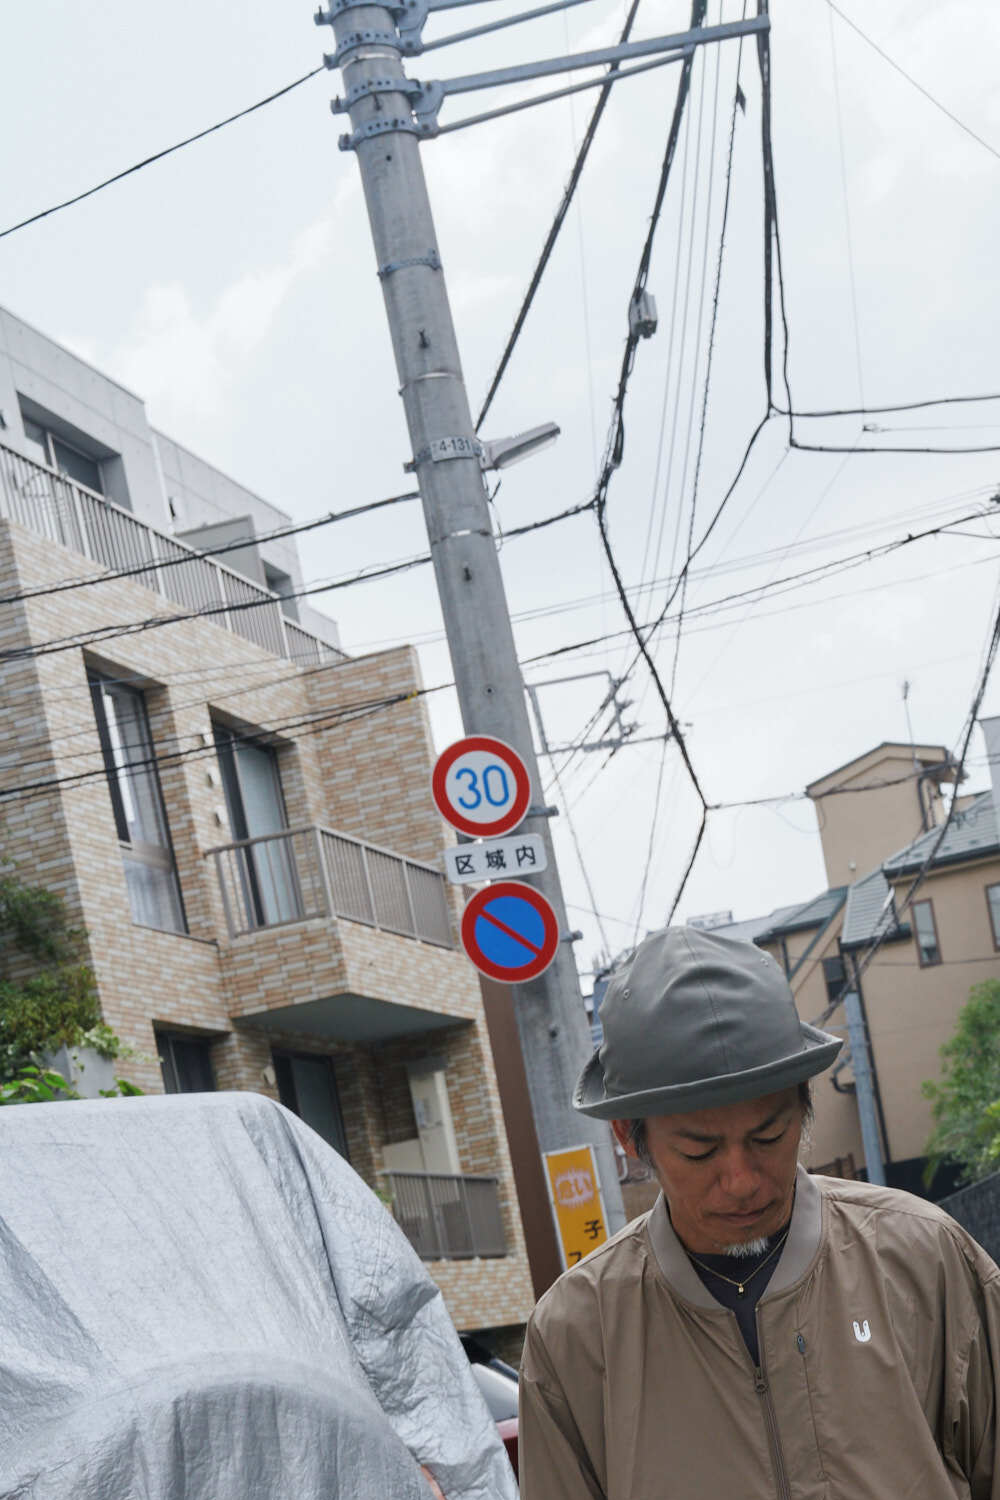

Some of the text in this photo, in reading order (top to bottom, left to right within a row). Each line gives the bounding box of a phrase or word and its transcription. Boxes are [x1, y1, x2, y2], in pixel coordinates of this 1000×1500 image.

[455, 764, 510, 810] 30
[455, 845, 536, 875] 区域内
